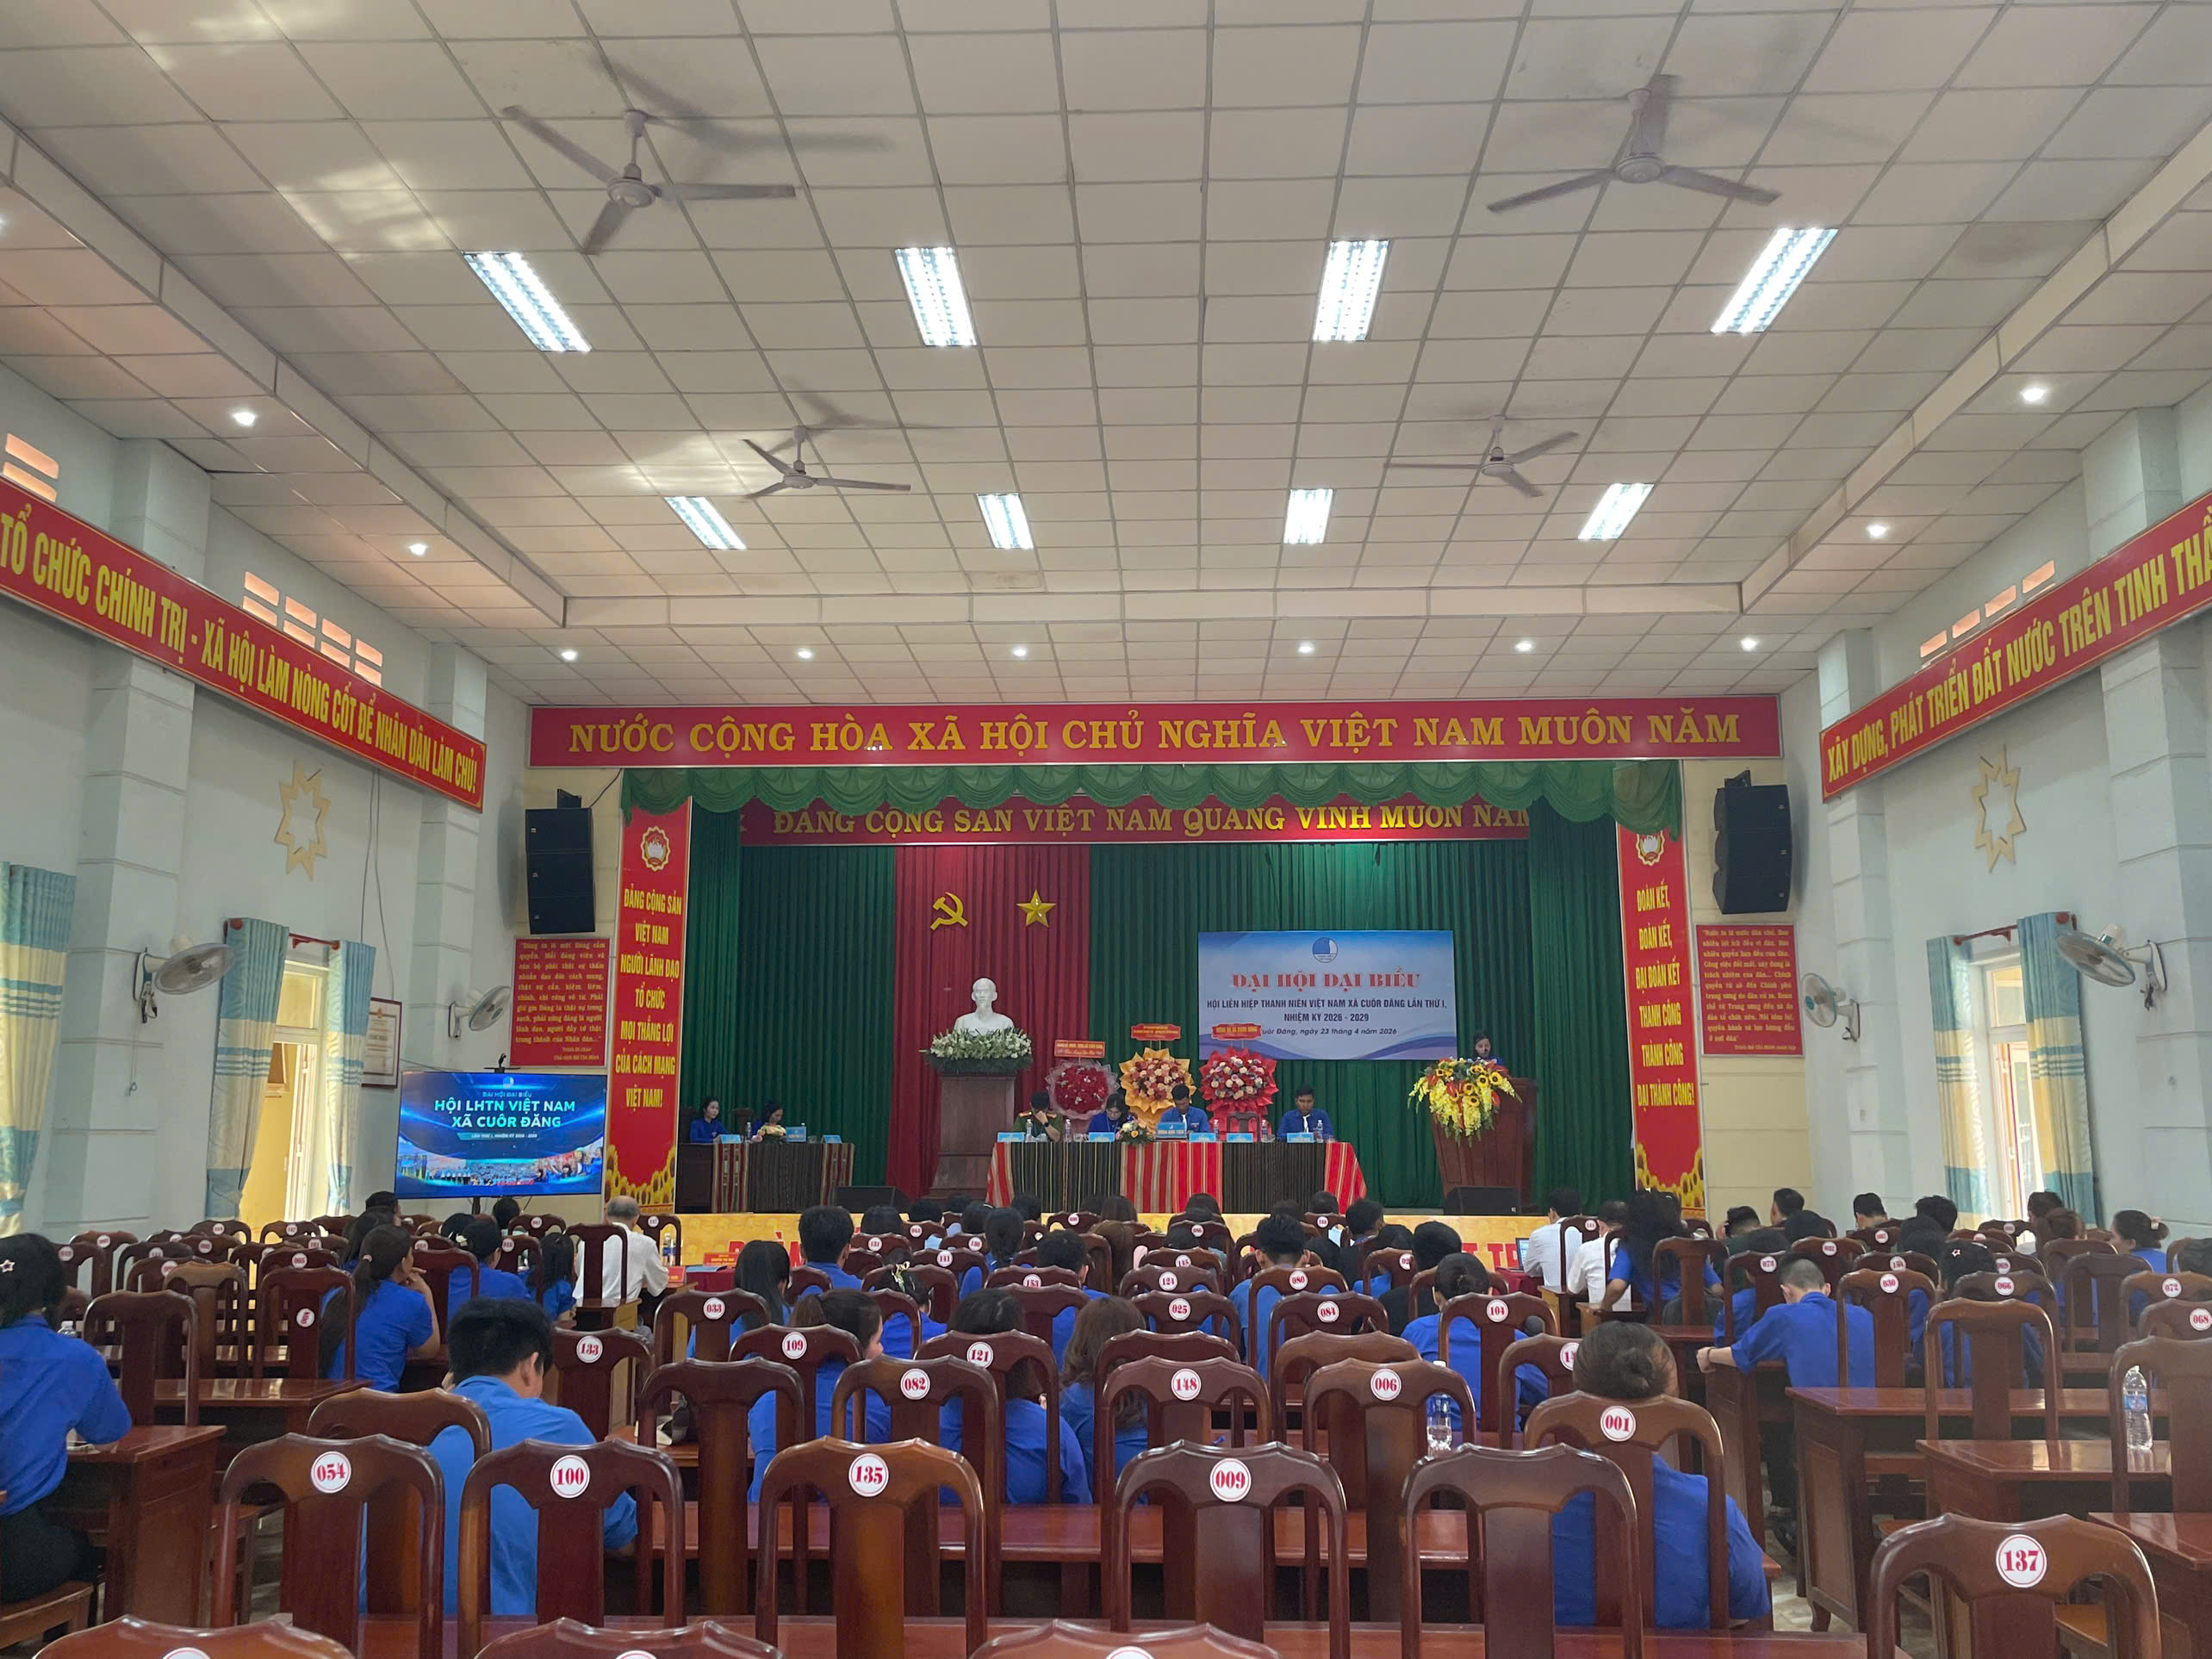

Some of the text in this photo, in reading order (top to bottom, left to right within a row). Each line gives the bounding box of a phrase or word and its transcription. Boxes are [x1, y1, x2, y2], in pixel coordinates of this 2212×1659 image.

[0, 503, 32, 575] TỔ
[33, 532, 91, 606] CHỨC
[96, 565, 156, 637] CHÍNH
[160, 596, 188, 664] TRỊ
[201, 617, 224, 674] XÃ
[228, 630, 255, 693] HỘI
[257, 645, 290, 704] LÀM
[291, 663, 331, 724] NÒNG
[333, 682, 357, 736] CỐT
[358, 692, 376, 745] ĐỂ
[376, 711, 407, 761] NHÂN
[408, 725, 432, 771] DÂN
[432, 736, 454, 784] LÀM
[1827, 735, 1849, 783] XÂY
[1852, 718, 1889, 773] DỰNG,
[1890, 692, 1923, 749] PHÁT
[1926, 657, 1969, 729] TRIỂN
[1972, 639, 2003, 705] ĐẤT
[2006, 618, 2055, 687] NƯỚC
[2059, 587, 2112, 656] TRÊN
[2114, 553, 2168, 627] TINH
[569, 707, 1741, 759] NƯỚC CỘNG HÒA XÃ HỘI CHỦ NGHĨA VIỆT NAM MUÔN NĂM
[1022, 803, 1095, 837] VIỆT
[1106, 808, 1172, 831] NAM
[1183, 806, 1285, 836] QUANG
[1295, 805, 1371, 830] VINH
[646, 888, 666, 916] CỘNG
[667, 890, 682, 916] SẢN
[635, 919, 669, 947] VIỆT NAM
[1277, 971, 1316, 992] HỘI
[1261, 999, 1286, 1008] THANH
[1327, 999, 1345, 1008] NAM
[1662, 999, 1681, 1026] CÔNG
[620, 1020, 635, 1045] MỌI
[1664, 1037, 1684, 1066] CÔNG
[615, 1047, 631, 1074] CỦA
[654, 1056, 675, 1078] MẠNG
[434, 1097, 575, 1114] HỘI LHTN VIỆT NAM
[626, 1084, 642, 1111] VIỆT
[451, 1114, 562, 1128] XÃ CUÔR ĐĂNG
[1172, 1304, 1188, 1314] 025
[786, 1340, 804, 1351] 109
[972, 1349, 989, 1362] 121
[904, 1376, 926, 1391] 082
[1176, 1377, 1197, 1391] 148
[1375, 1378, 1397, 1392] 006
[1605, 1415, 1630, 1432] 001
[317, 1462, 345, 1482] 054
[556, 1467, 585, 1486] 100
[854, 1465, 884, 1485] 135
[1215, 1469, 1246, 1488] 009
[2004, 1550, 2040, 1572] 137
